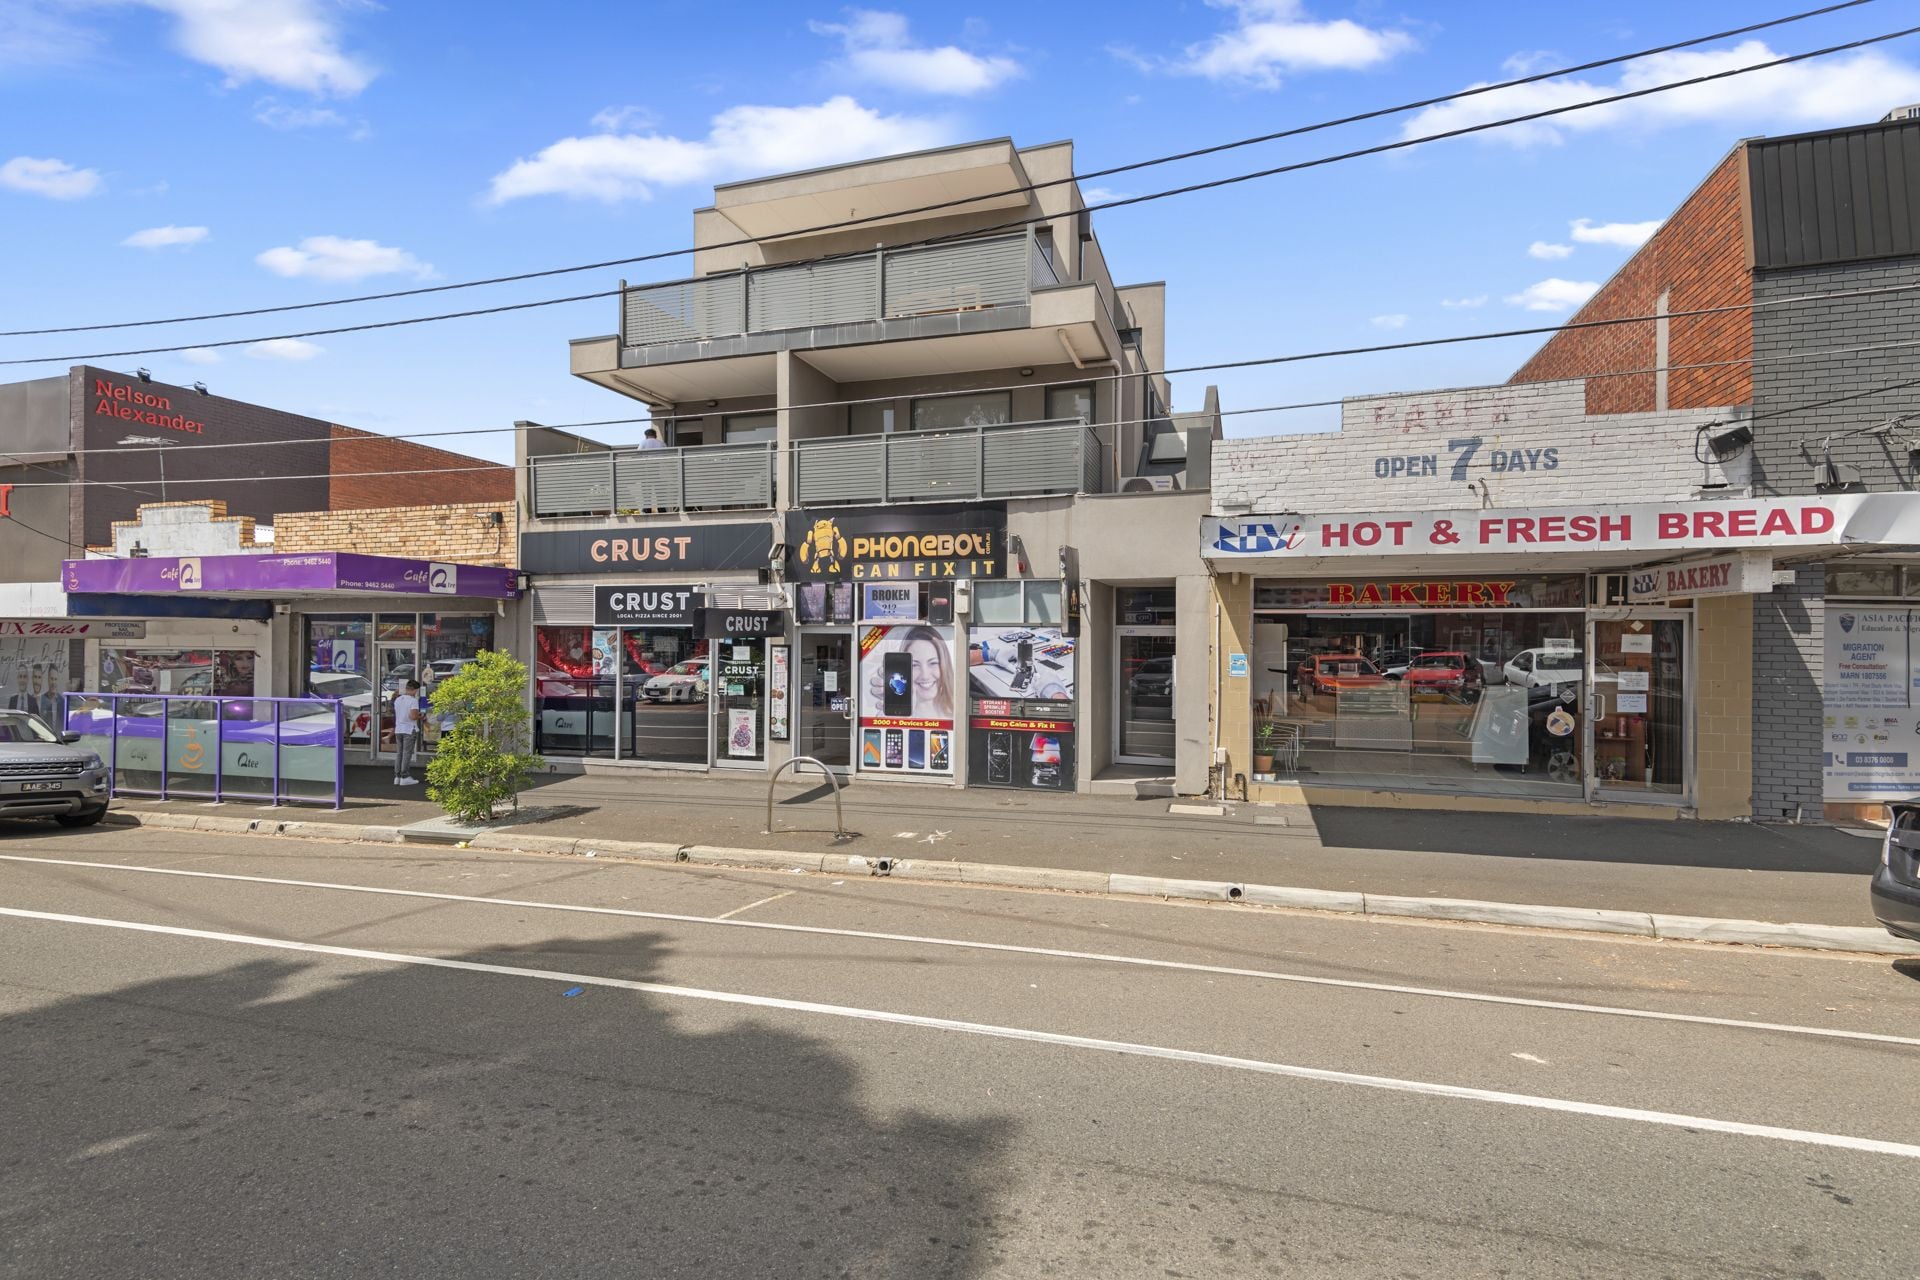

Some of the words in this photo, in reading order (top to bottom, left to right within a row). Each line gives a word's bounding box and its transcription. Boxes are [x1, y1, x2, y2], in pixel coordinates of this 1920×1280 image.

[96, 379, 171, 410] Nelson
[96, 399, 205, 434] Alexander
[1375, 455, 1437, 478] OPEN
[1447, 438, 1482, 481] 7
[1491, 447, 1559, 472] DAYS
[1322, 521, 1412, 547] HOT
[1429, 519, 1461, 545] &
[1480, 515, 1632, 544] FRESH
[1658, 507, 1835, 540] BREAD
[591, 537, 692, 562] CRUST
[160, 567, 179, 581] Café
[403, 569, 429, 583] Café
[853, 563, 900, 578] CAN
[914, 562, 956, 577] FIX
[971, 560, 995, 576] IT
[1666, 562, 1732, 592] BAKERY
[340, 580, 364, 588] Phone:
[609, 592, 690, 611] CRUST
[872, 589, 911, 601] BROKEN
[1327, 581, 1516, 605] BAKERY
[726, 616, 769, 632] CRUST
[1862, 614, 1884, 622] ASIA
[29, 622, 75, 634] Nails
[1843, 643, 1884, 652] MIGRATION
[724, 666, 759, 674] CRUST
